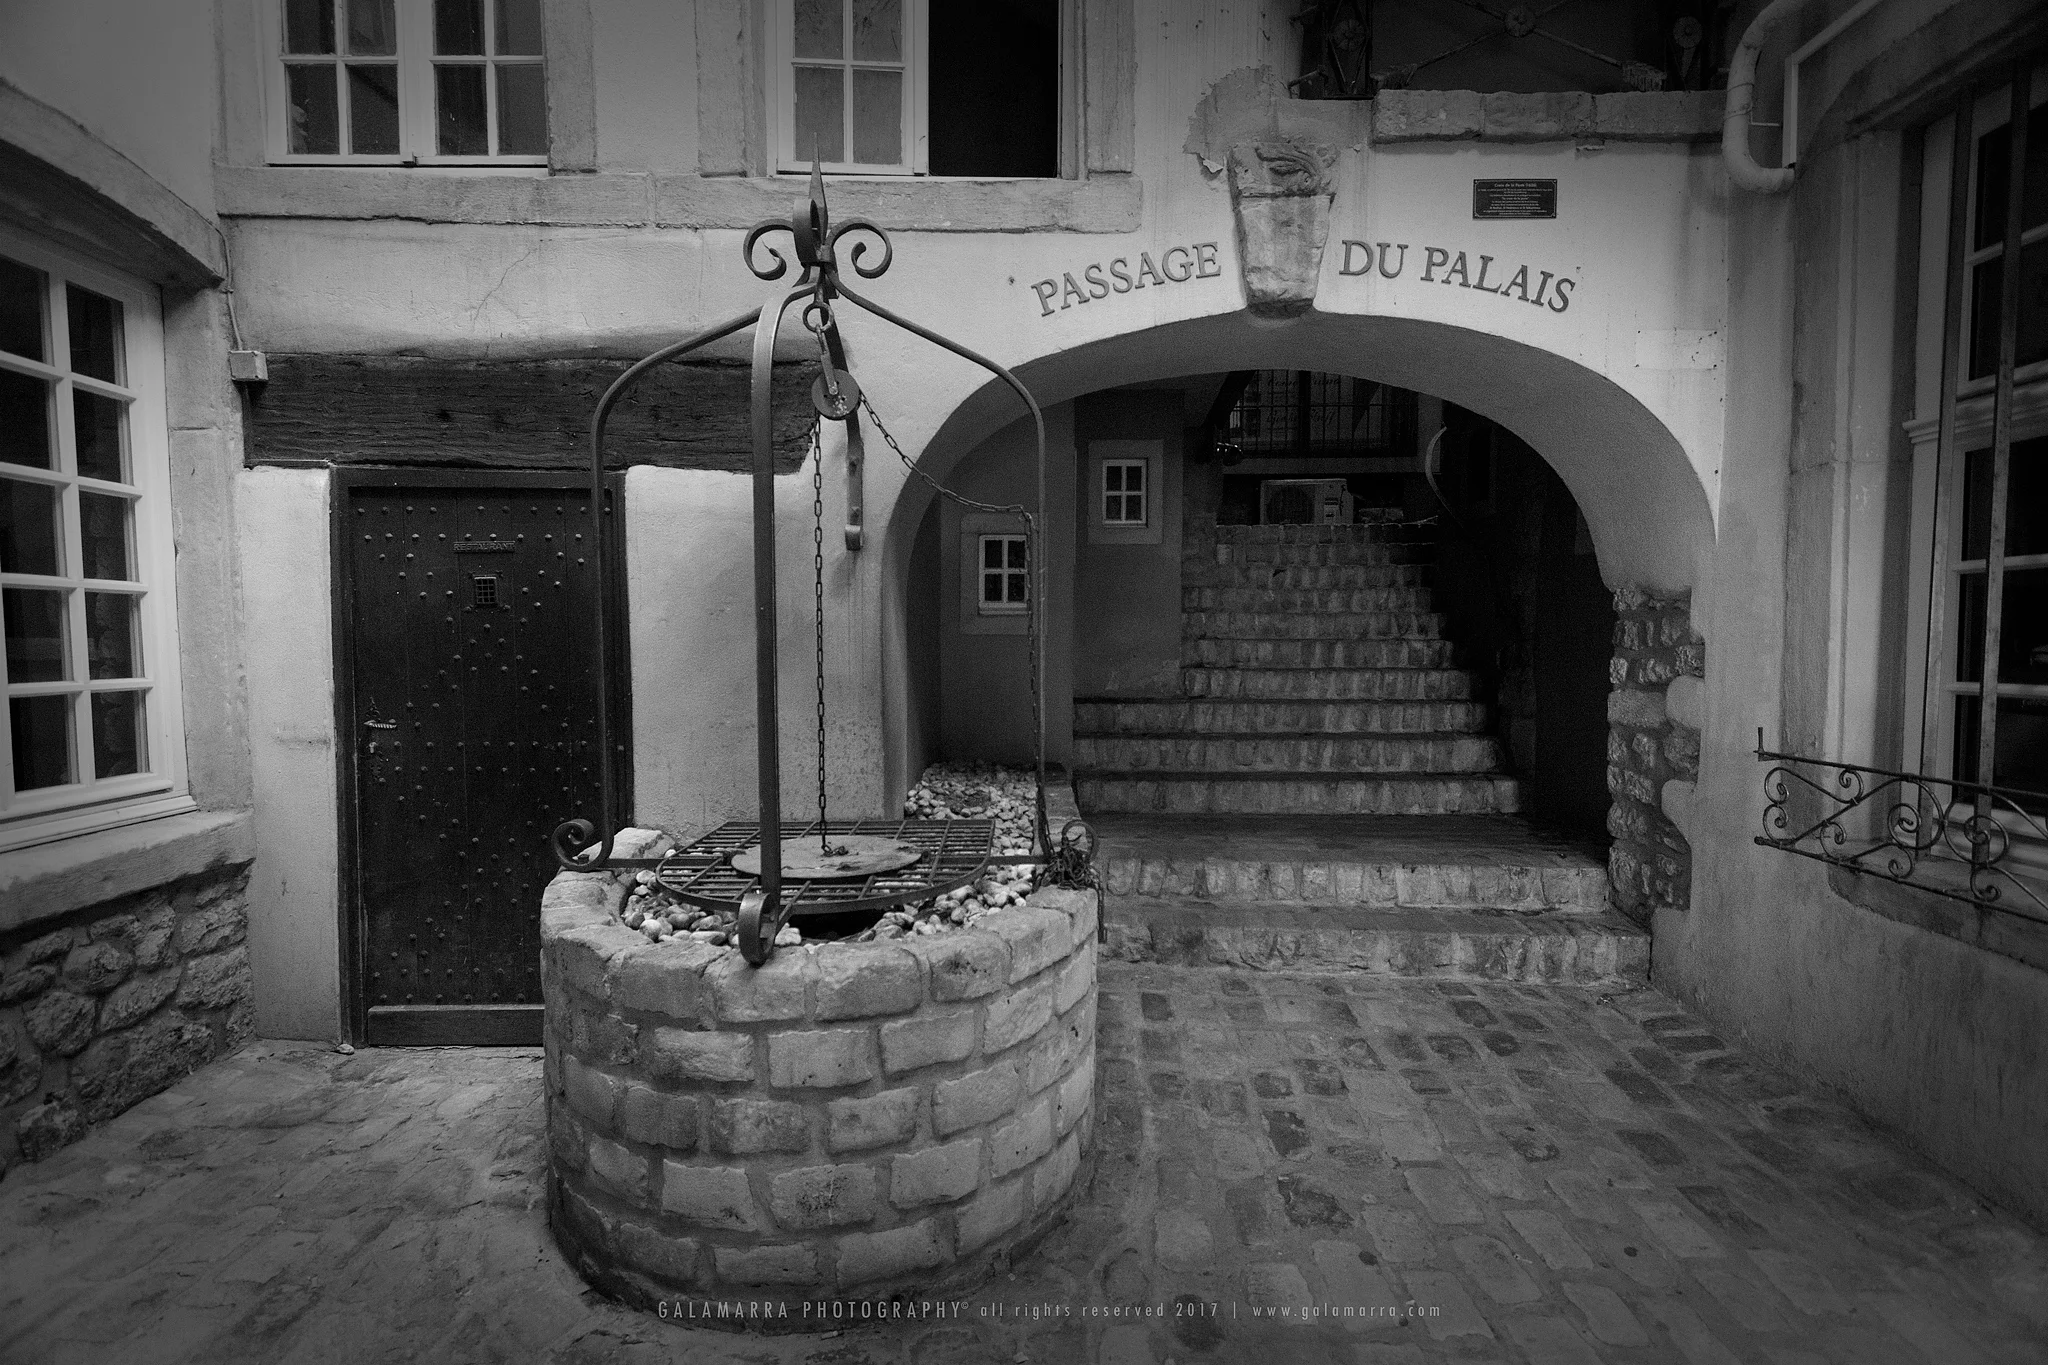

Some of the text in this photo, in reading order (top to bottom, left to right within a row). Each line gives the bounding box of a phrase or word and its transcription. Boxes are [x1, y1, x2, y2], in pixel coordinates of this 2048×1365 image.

[1032, 240, 1576, 317] PASSAGE DU PALAIS
[453, 543, 515, 551] RESTAURANT
